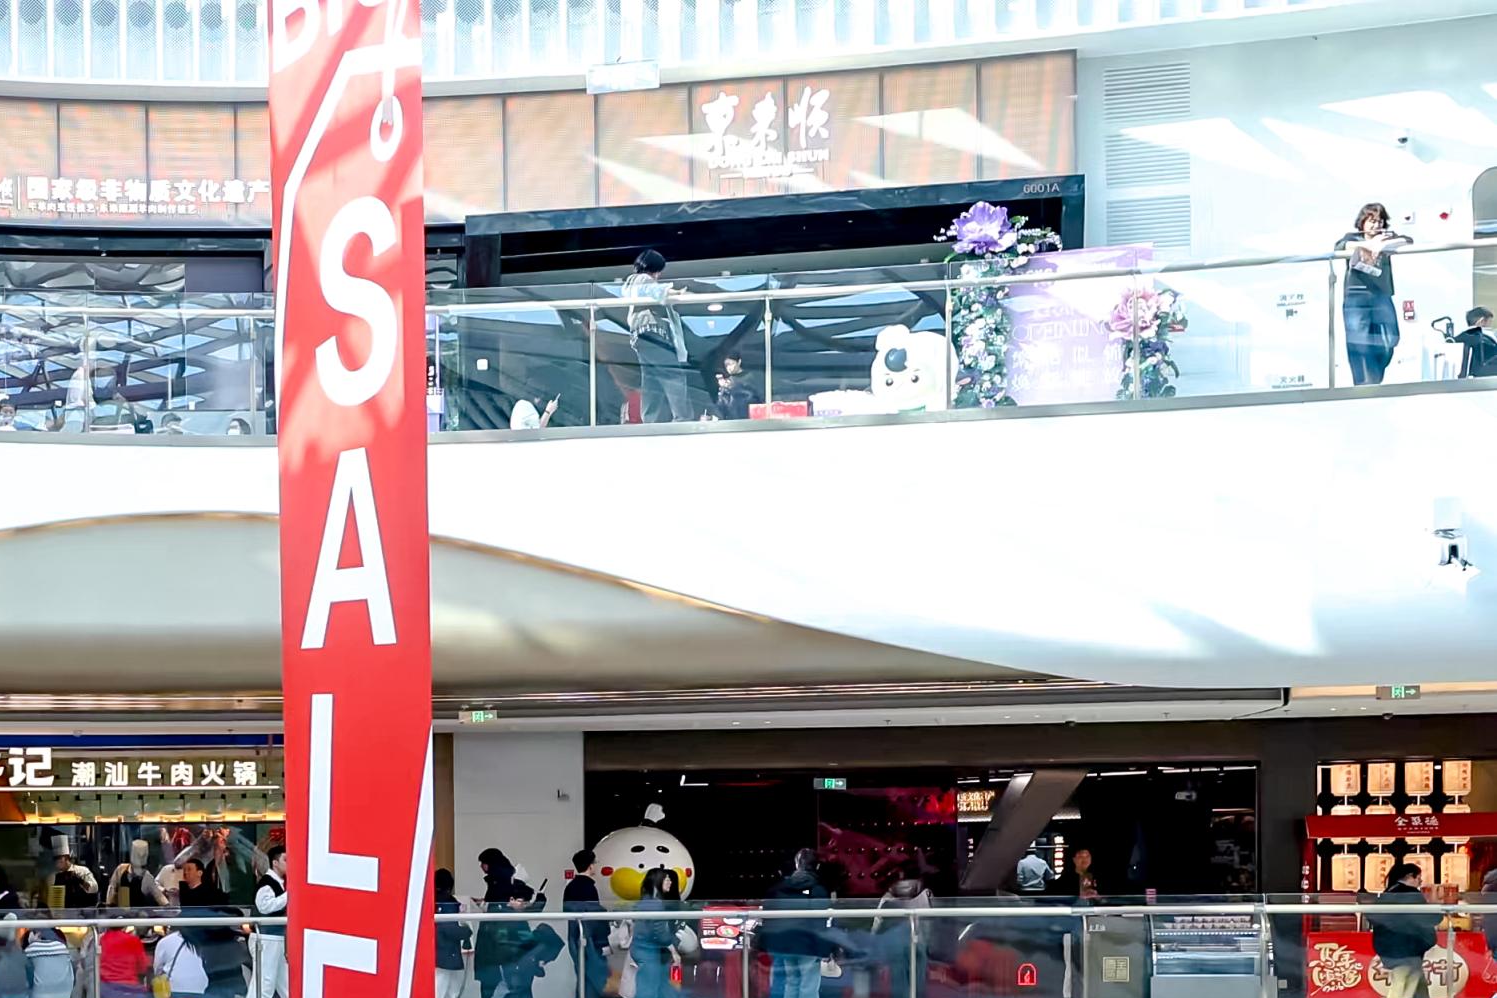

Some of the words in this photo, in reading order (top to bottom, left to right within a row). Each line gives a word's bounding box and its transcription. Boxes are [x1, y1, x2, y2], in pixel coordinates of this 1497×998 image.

[71, 760, 258, 787] 潮汕牛肉火锅
